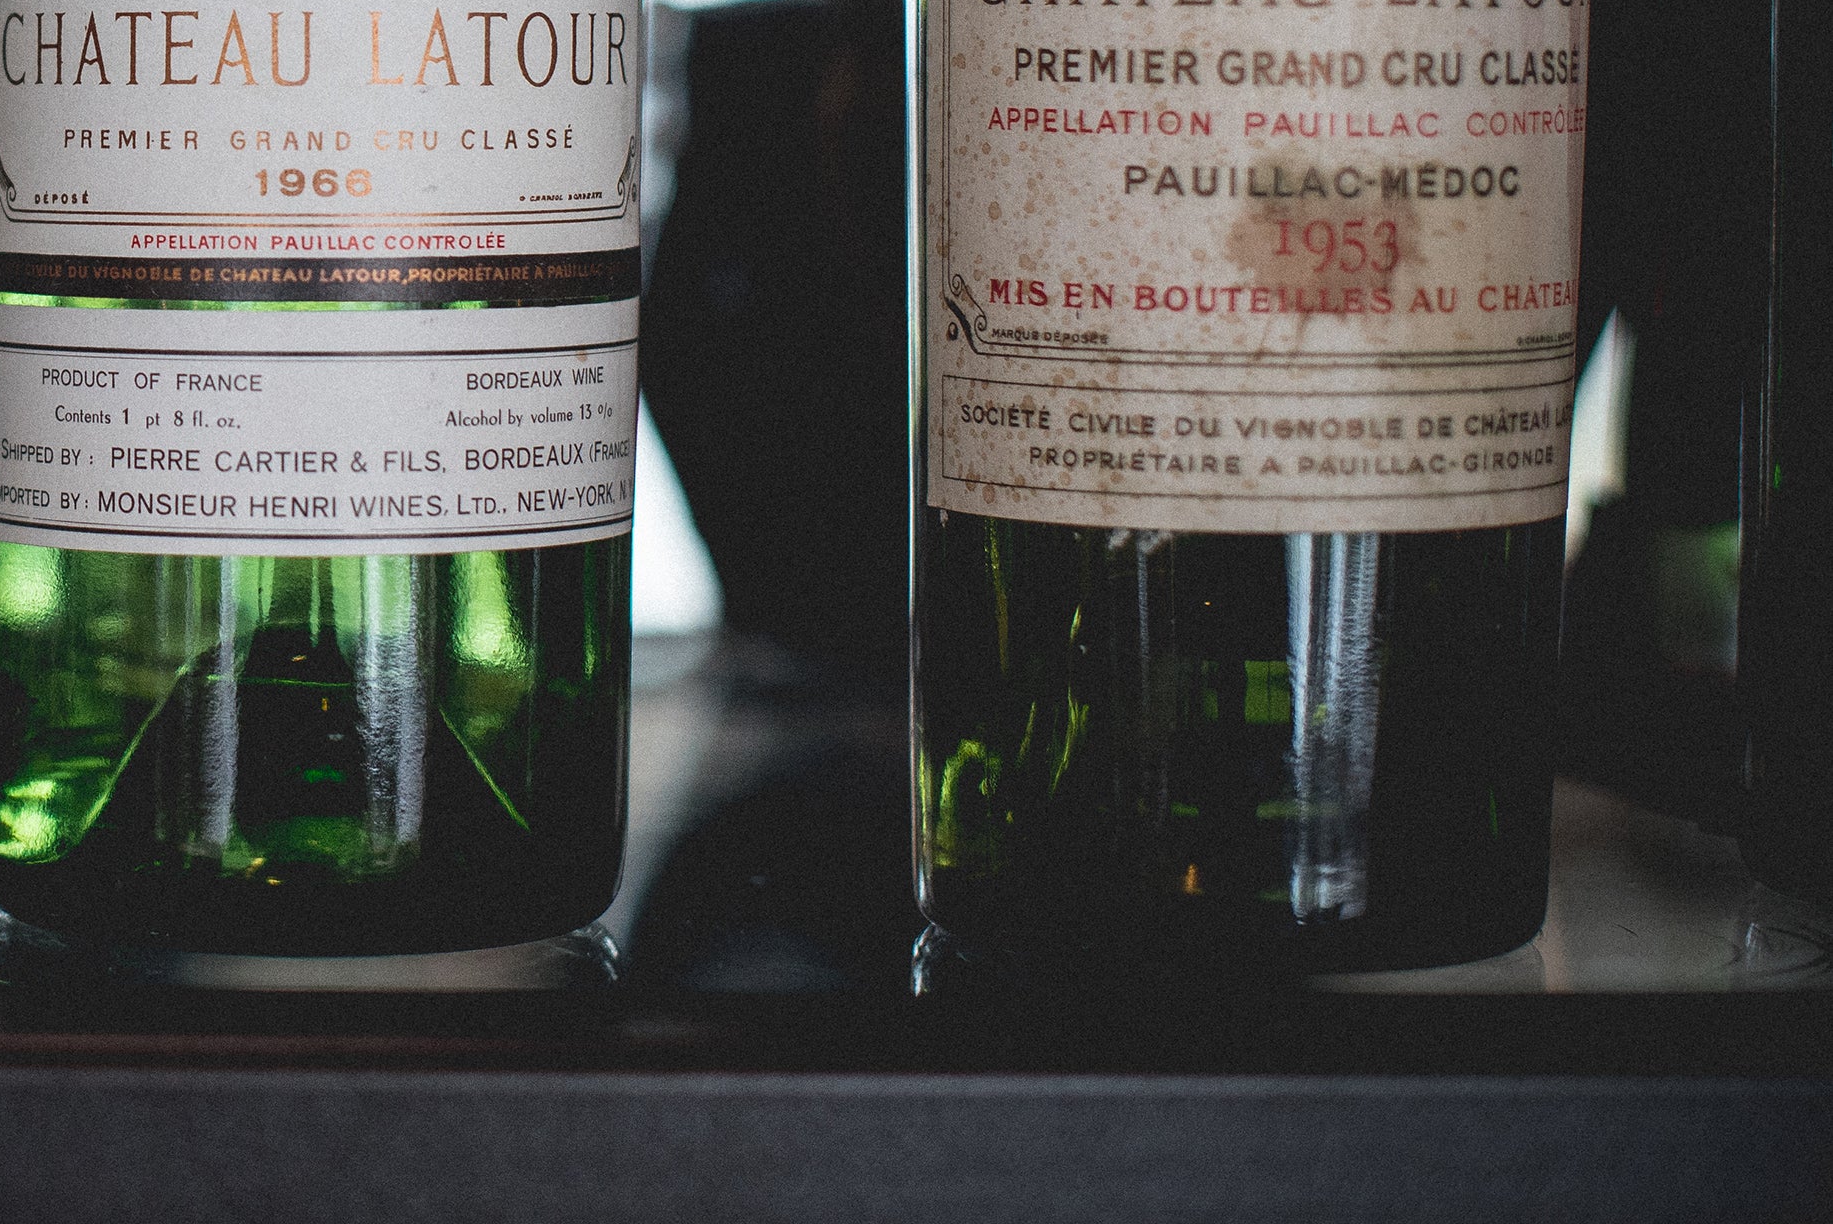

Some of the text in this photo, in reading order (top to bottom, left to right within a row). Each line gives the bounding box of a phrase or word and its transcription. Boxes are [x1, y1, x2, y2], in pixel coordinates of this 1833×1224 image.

[2, 7, 629, 87] CHATEAU LATOUR
[1013, 46, 1199, 83] PREMIER
[1216, 49, 1366, 88] GRAND
[1381, 48, 1462, 87] CRU
[64, 123, 575, 152] PREMIER GRAND CRU CLASSÉ
[987, 106, 1211, 138] APPELLATION
[1243, 110, 1440, 139] PAUILLAC
[254, 168, 373, 199] 1966
[1123, 162, 1521, 200] PAUILLAC-MÉDOC
[131, 230, 506, 253] APPELLATION PAUILLAC CONTROLÉE
[1273, 220, 1400, 276] 1953
[68, 266, 88, 280] DU
[93, 266, 183, 283] VIGNOBLE
[191, 267, 215, 283] DE
[220, 266, 312, 284] CHATEAU
[988, 278, 1049, 307] MIS
[1063, 283, 1115, 310] EN
[1133, 284, 1394, 314] BOUTEILLES
[1409, 286, 1458, 314] AU
[42, 367, 264, 393] PRODUCT OF FRANCE
[466, 365, 605, 391] BORDEAUX WINE
[55, 404, 242, 430] Contents 1 pt 8 fl. oz.
[445, 408, 503, 428] Alcohol
[508, 407, 524, 427] by
[530, 408, 574, 425] volume
[579, 404, 593, 422] 13
[960, 403, 1051, 431] SOCIÉTÉ
[1068, 412, 1156, 435] CIVILE
[1175, 416, 1221, 439] DU
[1235, 416, 1405, 440] VIGNOBLE
[1417, 415, 1454, 438] DE
[61, 449, 82, 466] BY
[110, 446, 201, 472] PIERRE
[215, 450, 338, 474] CARTIER
[350, 450, 369, 473] &
[383, 449, 447, 475] FILS,
[465, 442, 585, 471] BORDEAUX
[1029, 445, 1243, 475] PROPRIÉTAIRE
[1296, 445, 1554, 477] PAUILLAC-GIRONDE
[98, 490, 237, 517] MONSIEUR
[249, 495, 337, 519] HENRI
[350, 494, 449, 519] WINES,
[517, 483, 617, 514] NEW-YORK,
